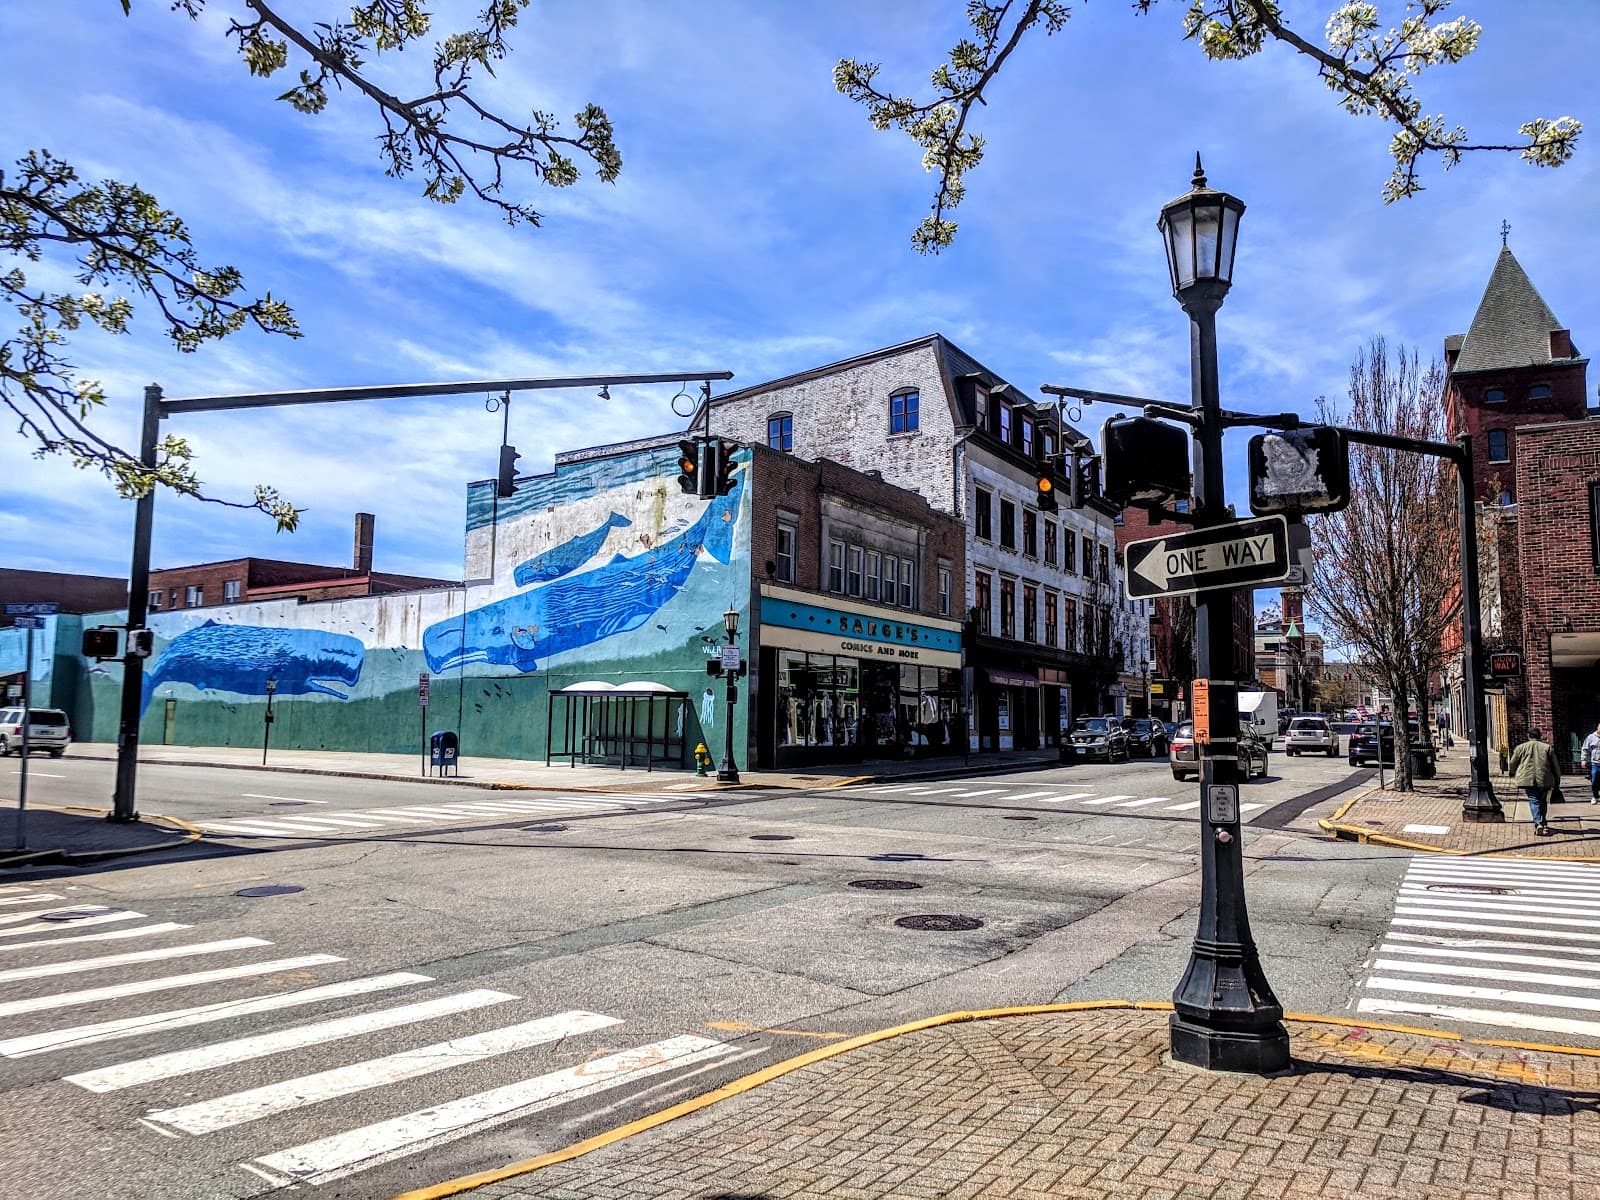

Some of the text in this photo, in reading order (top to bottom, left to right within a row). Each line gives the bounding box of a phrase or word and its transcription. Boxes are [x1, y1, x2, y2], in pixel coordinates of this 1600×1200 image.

[1166, 537, 1269, 576] ONE WAY
[839, 617, 919, 642] SARGE'S
[840, 641, 919, 660] COMICS AND MORE
[1494, 662, 1517, 670] WALK
